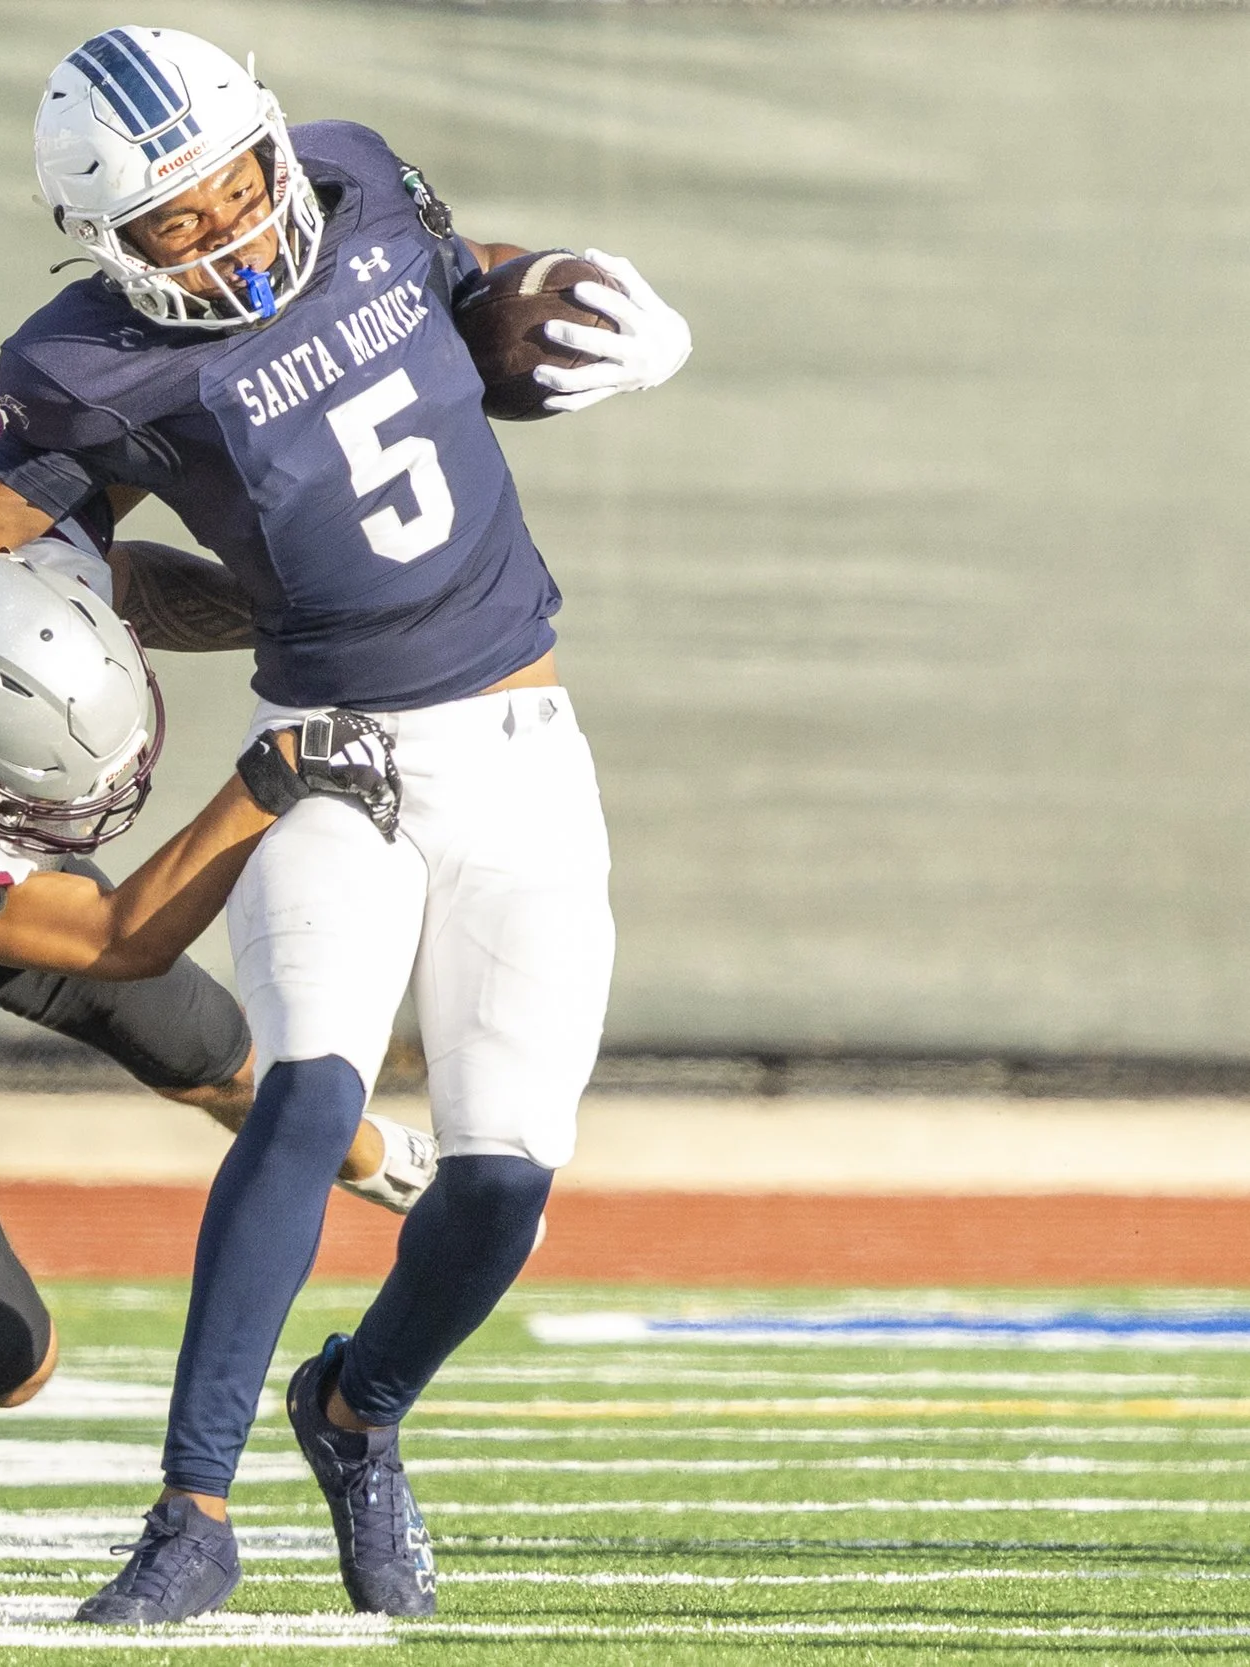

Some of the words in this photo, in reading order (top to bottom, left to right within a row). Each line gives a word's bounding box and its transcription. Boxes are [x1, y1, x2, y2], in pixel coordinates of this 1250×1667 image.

[236, 335, 346, 427] SANTA
[335, 279, 429, 367] MONICA
[325, 367, 456, 564] 5
